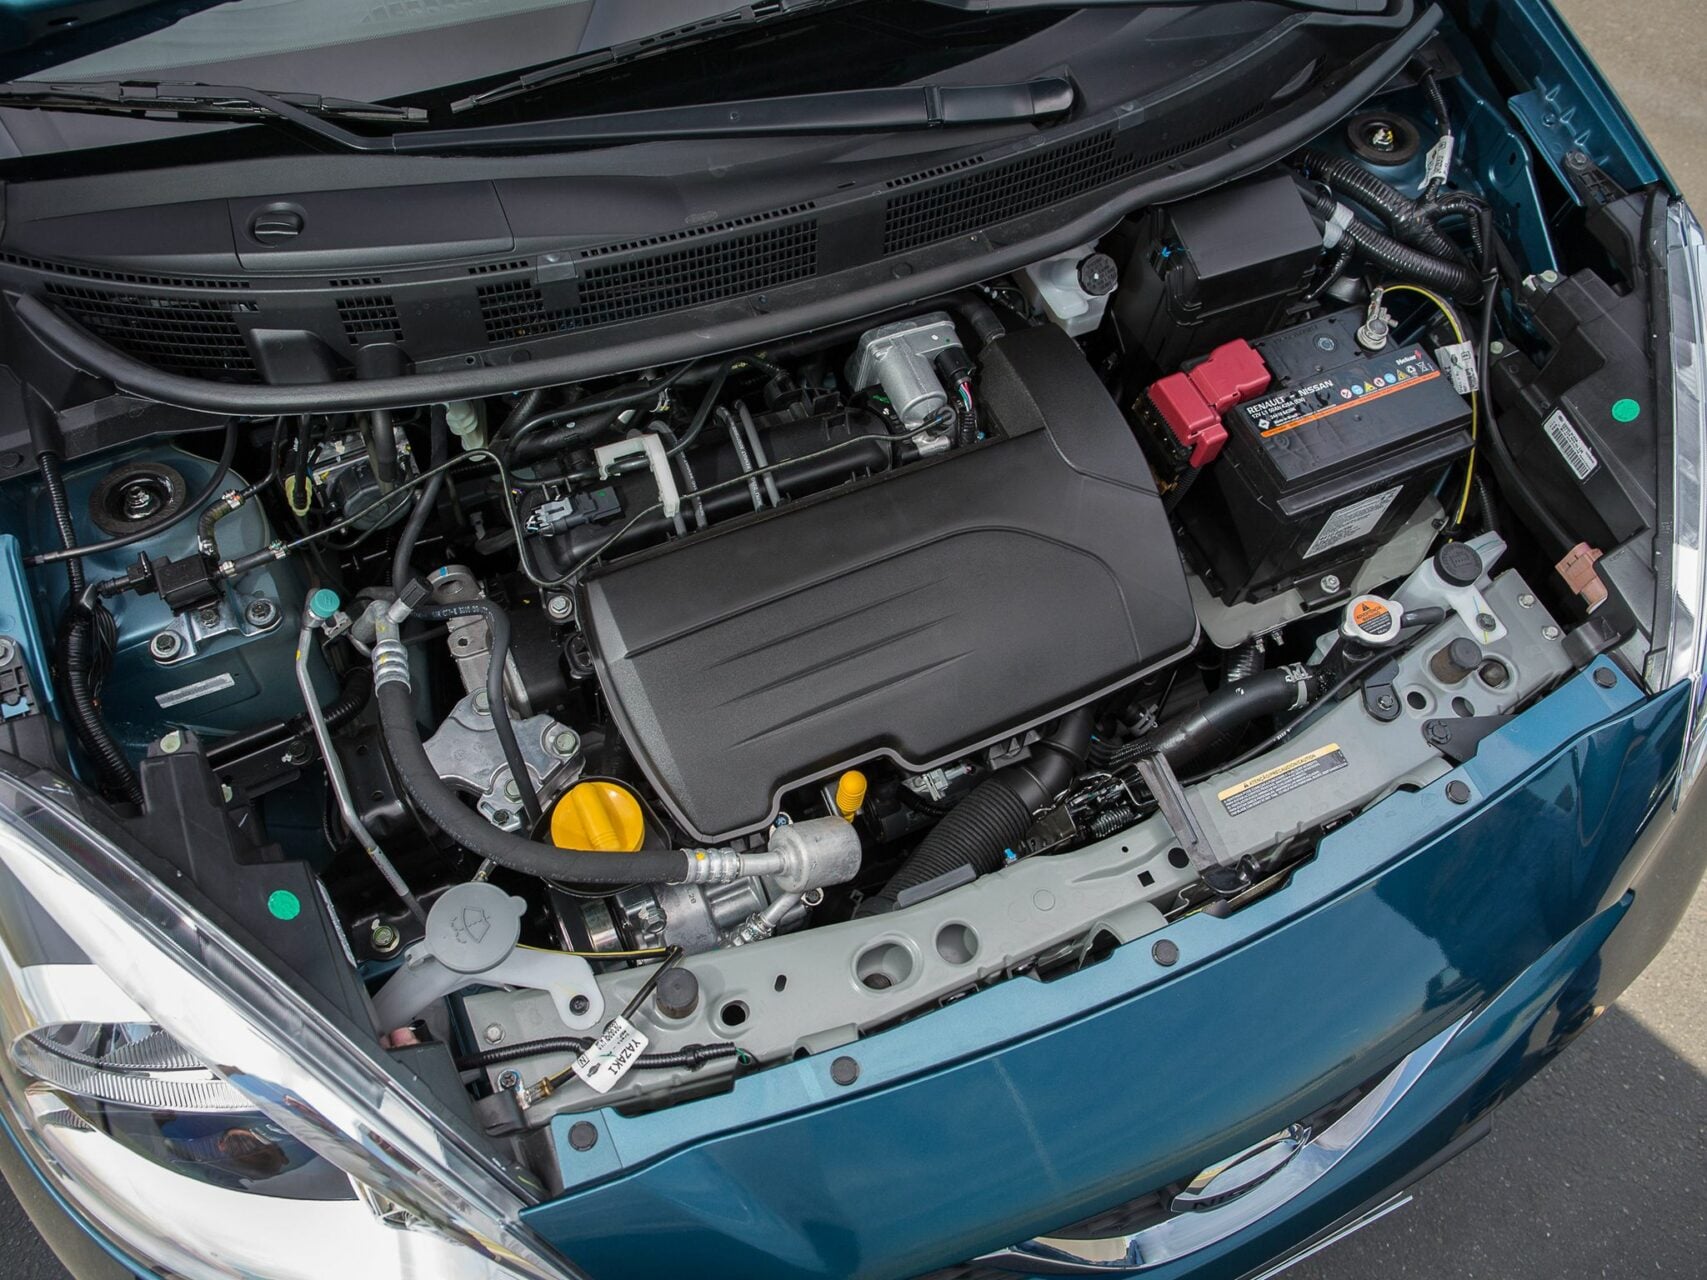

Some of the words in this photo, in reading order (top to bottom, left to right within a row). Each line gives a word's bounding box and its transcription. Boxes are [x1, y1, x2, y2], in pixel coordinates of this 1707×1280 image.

[1246, 395, 1285, 415] RENAULT
[1297, 379, 1334, 396] NISSAN
[608, 1038, 641, 1075] YAZAKI
